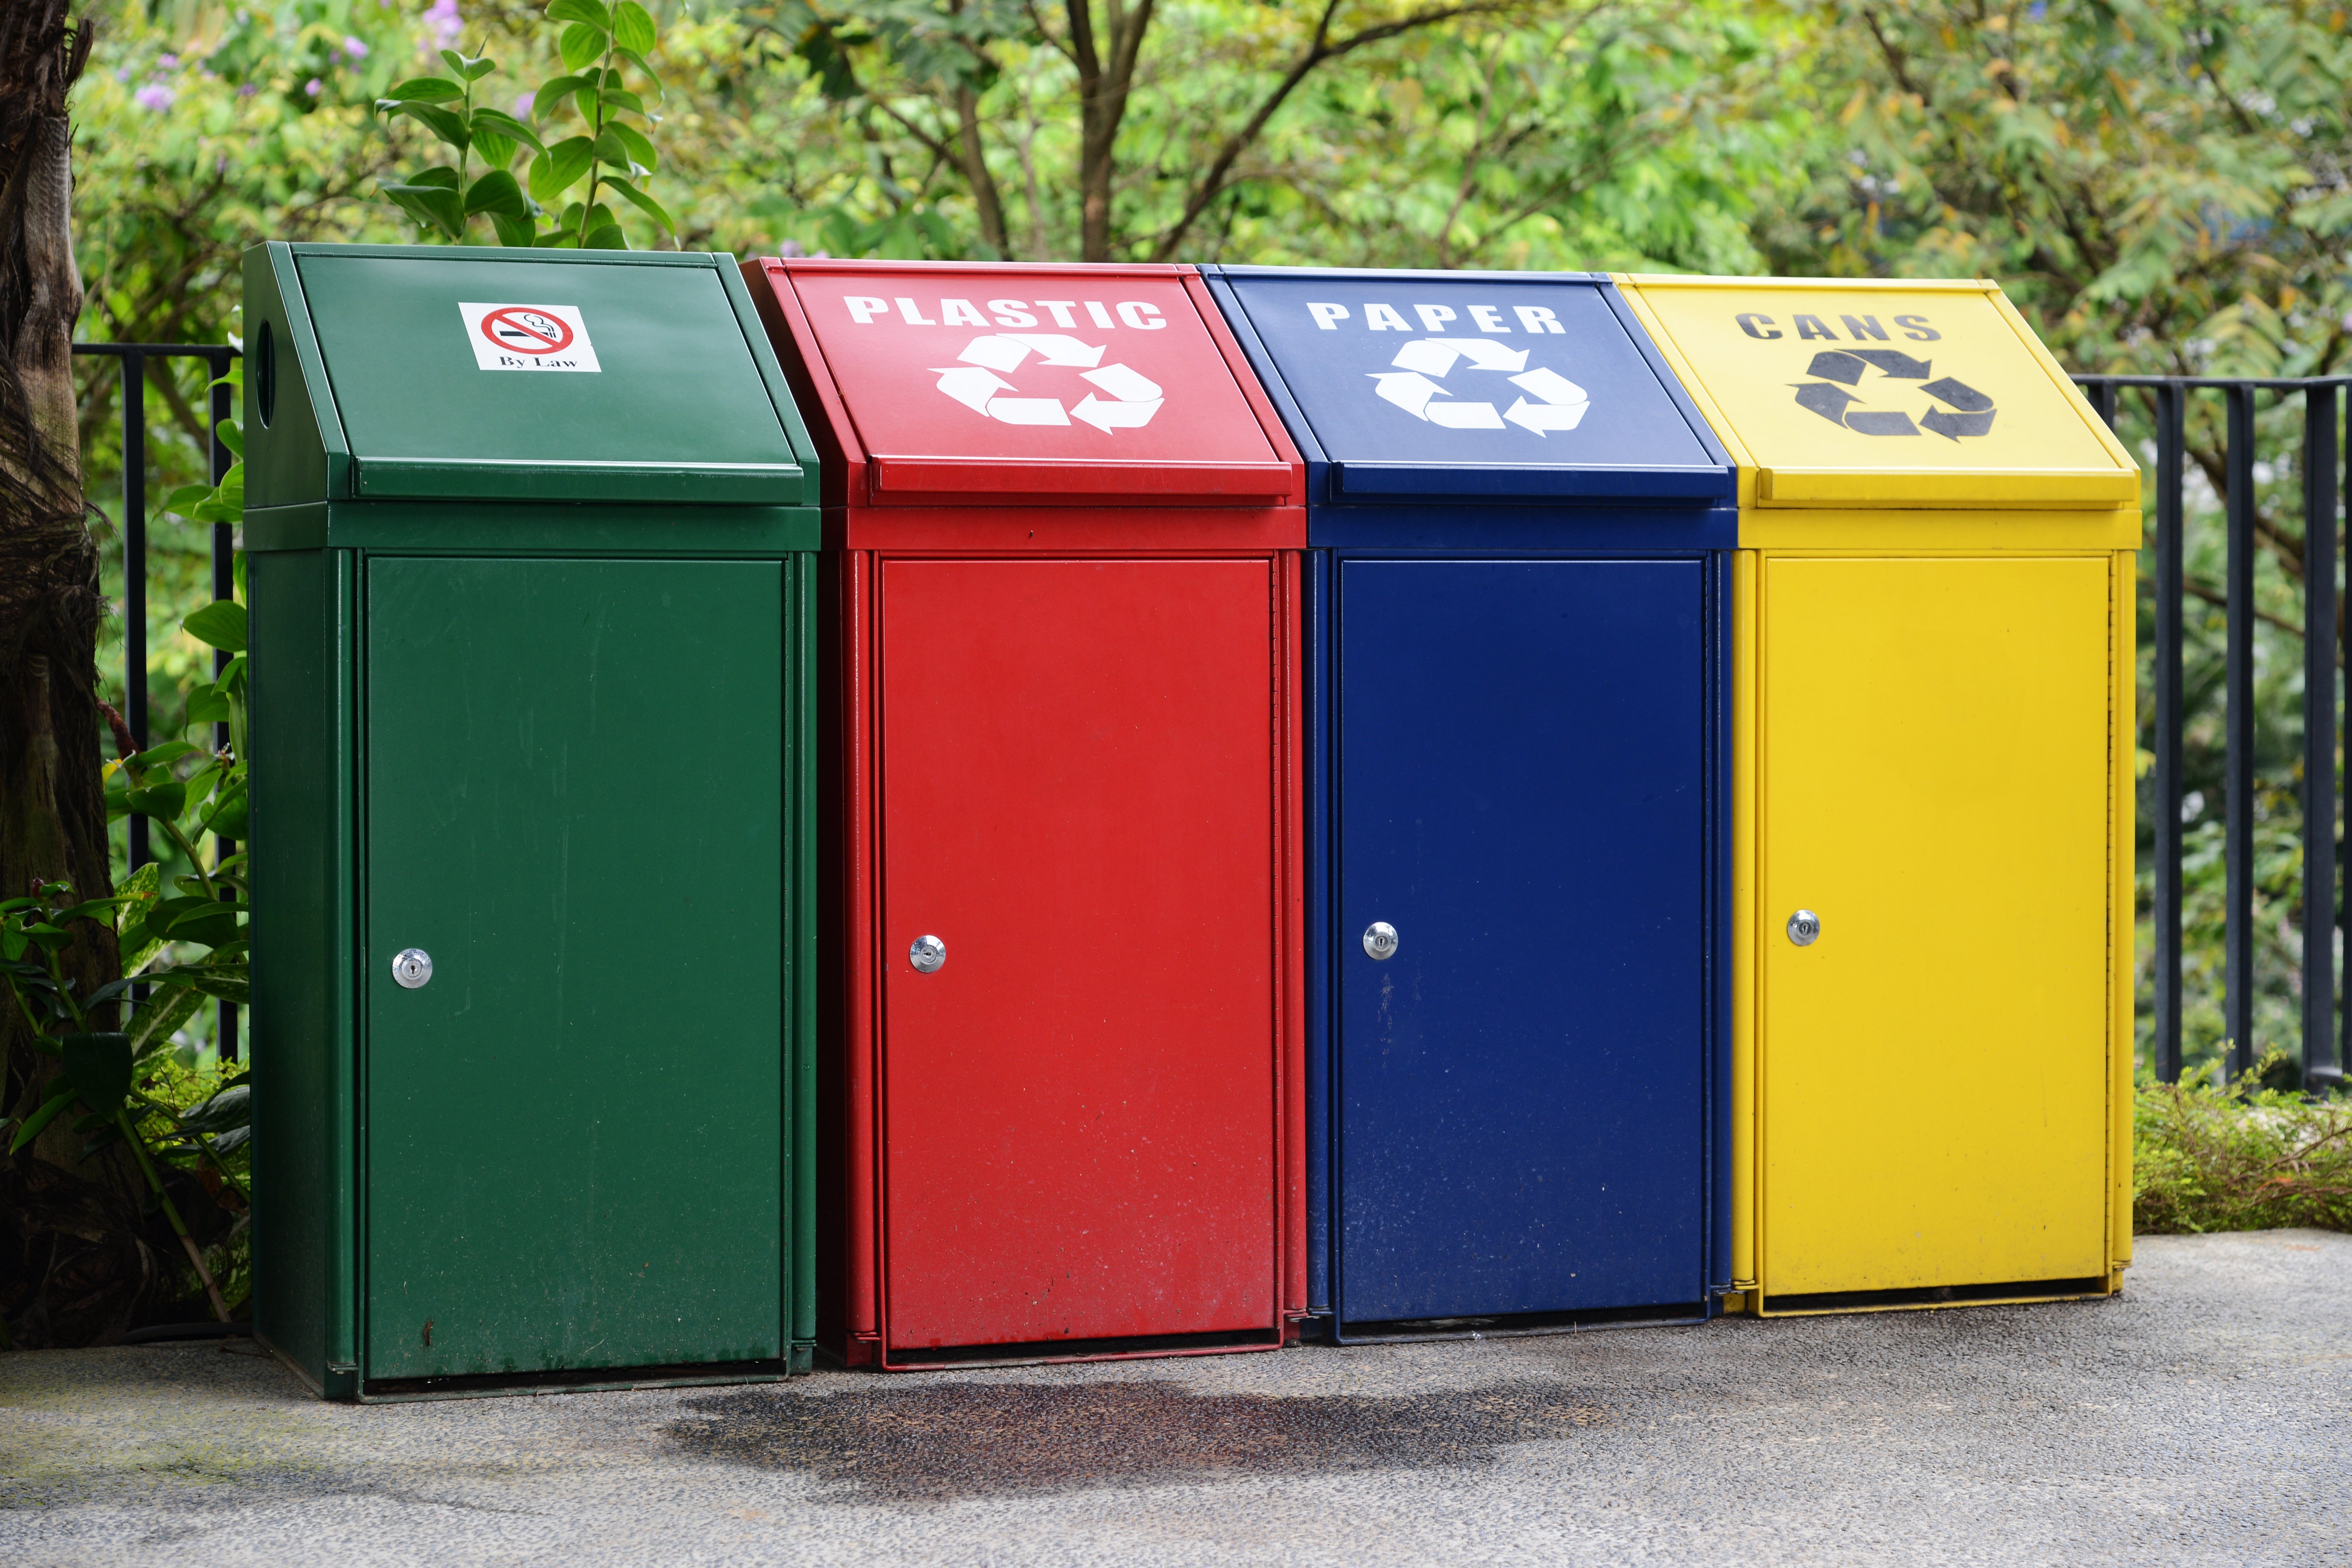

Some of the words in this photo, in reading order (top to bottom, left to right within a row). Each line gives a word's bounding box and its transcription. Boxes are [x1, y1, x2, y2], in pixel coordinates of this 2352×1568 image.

[843, 296, 1167, 330] PLASTIC
[1306, 302, 1566, 334] PAPER
[1735, 313, 1942, 341] CANS
[499, 356, 525, 368] By
[533, 357, 577, 367] Law
